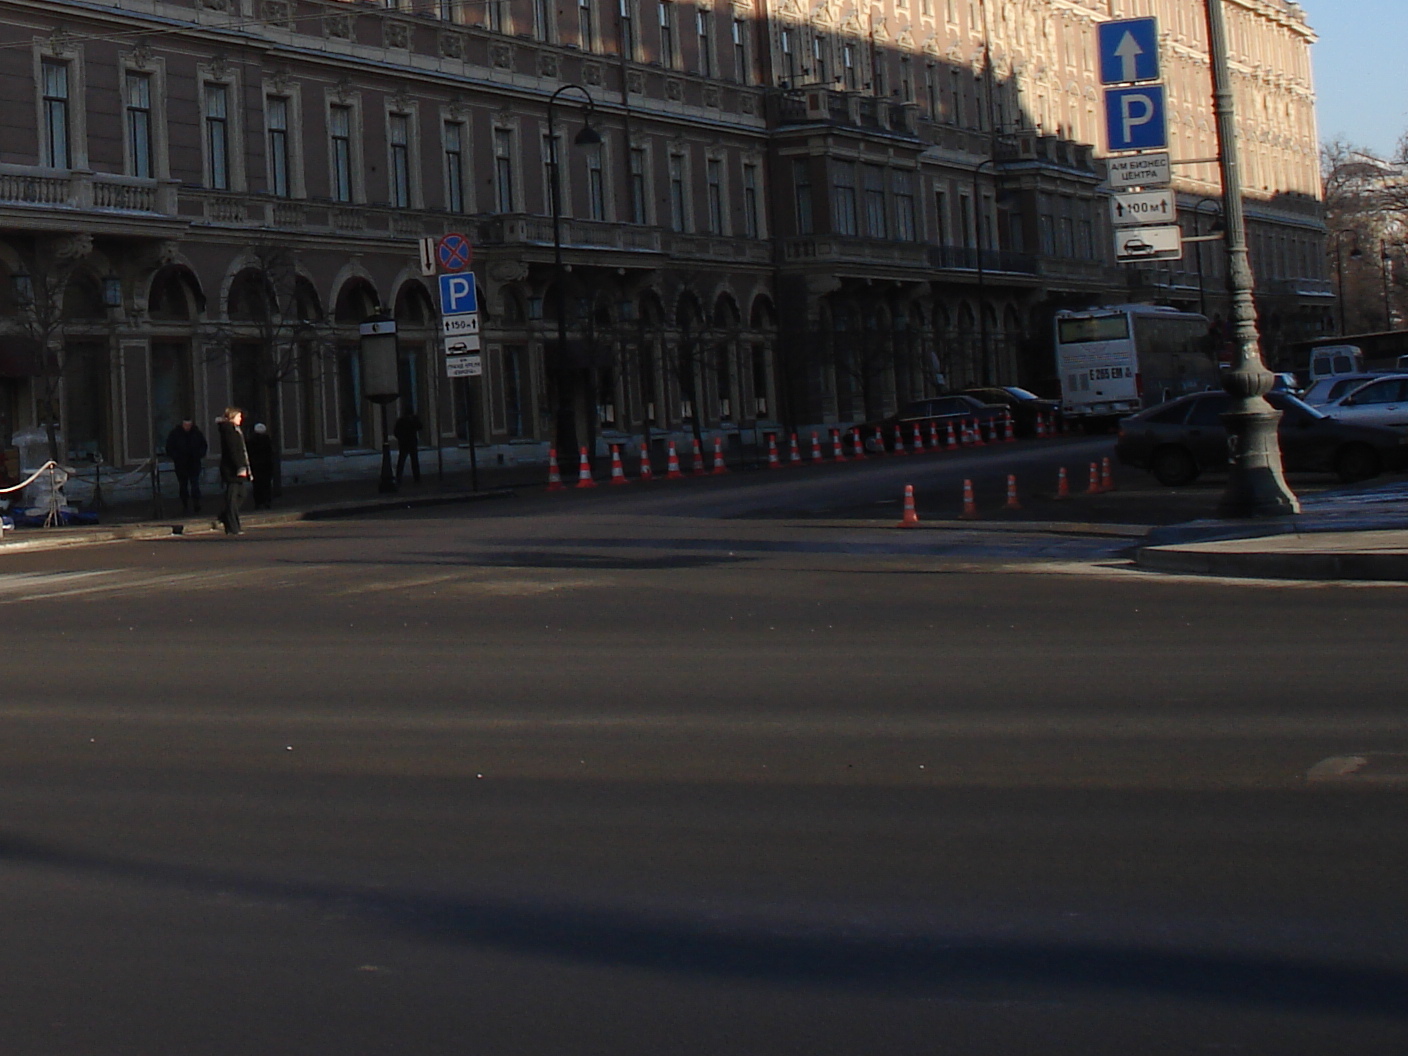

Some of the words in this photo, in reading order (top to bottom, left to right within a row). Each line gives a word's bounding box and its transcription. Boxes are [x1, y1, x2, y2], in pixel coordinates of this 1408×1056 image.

[1121, 94, 1154, 143] P
[1129, 159, 1166, 170] БИЗНЕС
[1121, 169, 1158, 181] ЦЕНТРА
[1127, 202, 1148, 214] 100
[449, 277, 470, 310] P
